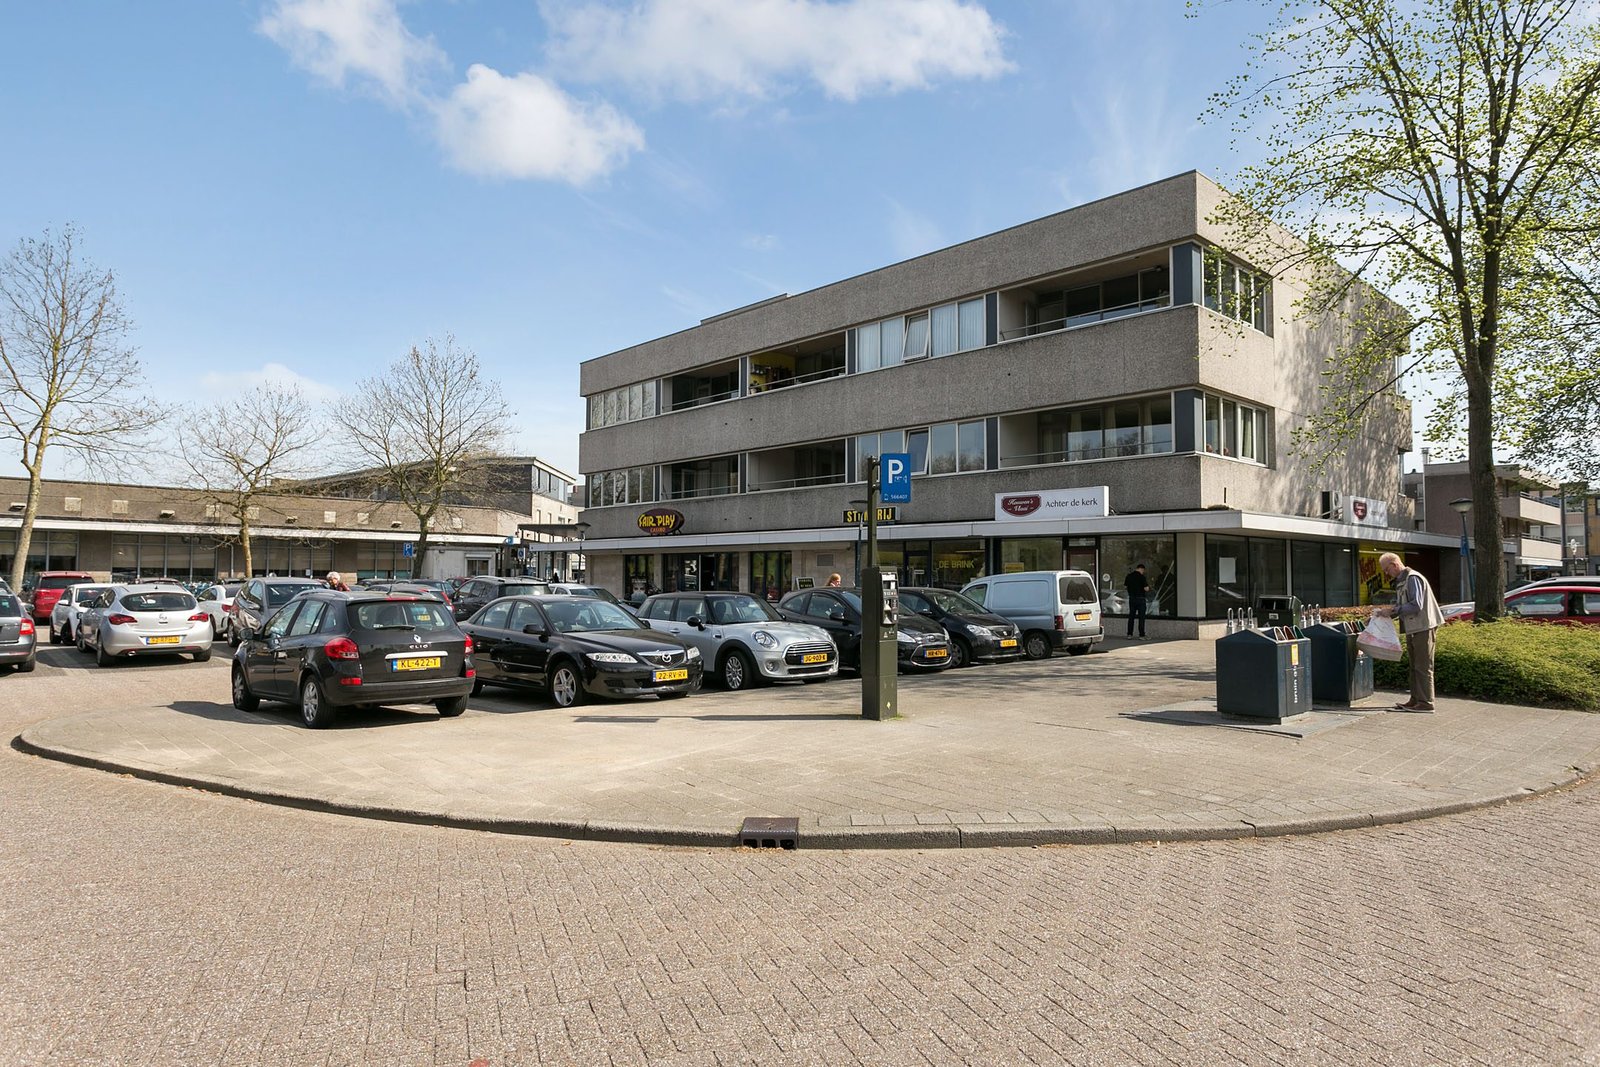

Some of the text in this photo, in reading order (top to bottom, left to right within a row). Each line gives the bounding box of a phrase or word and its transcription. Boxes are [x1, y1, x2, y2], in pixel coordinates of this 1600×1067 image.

[888, 459, 904, 484] P
[1045, 497, 1098, 508] Achter de kerk
[847, 508, 892, 522] STRIJ
[639, 513, 675, 529] FAIR PLAY
[938, 560, 975, 569] DE BRINK
[401, 658, 437, 668] KL-422-T
[658, 670, 687, 680] 22-RV-RV
